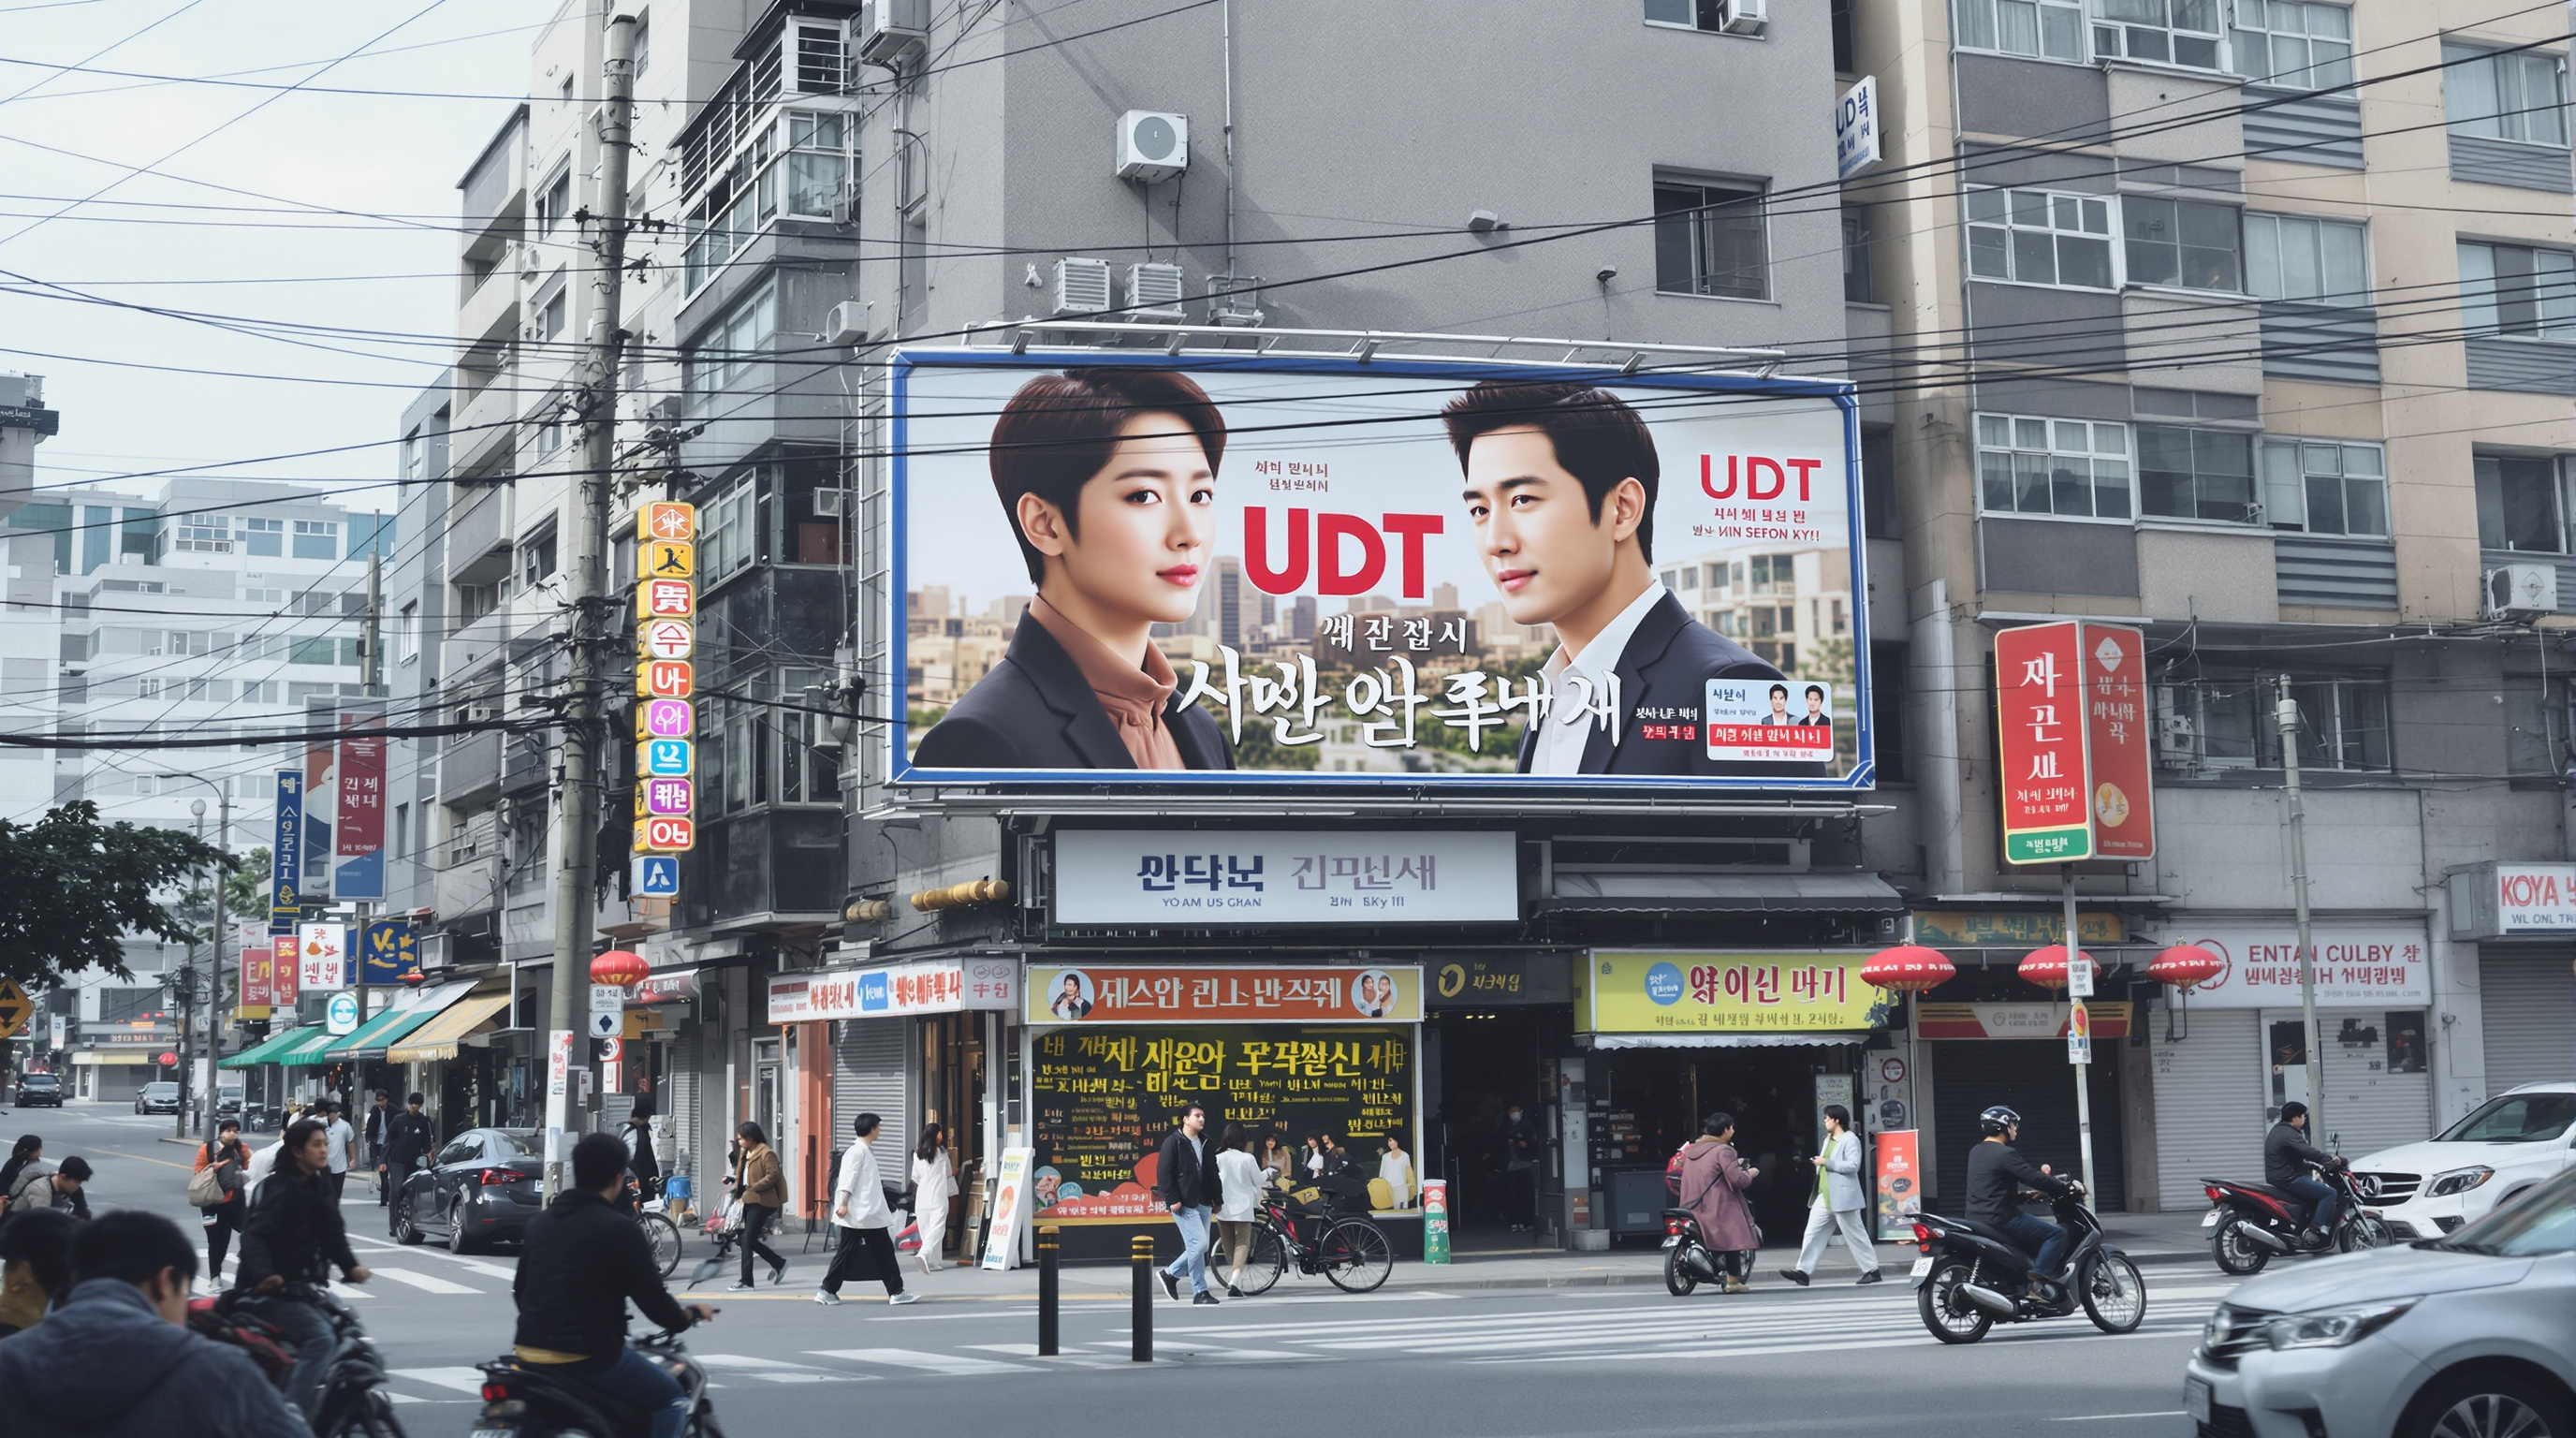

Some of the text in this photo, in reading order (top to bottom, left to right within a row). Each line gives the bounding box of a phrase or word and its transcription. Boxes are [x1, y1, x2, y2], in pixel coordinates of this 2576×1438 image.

[1700, 454, 1822, 502] UDT
[1243, 506, 1444, 599] UDT
[2501, 875, 2560, 907] KOYA
[2326, 945, 2394, 962] CULBY
